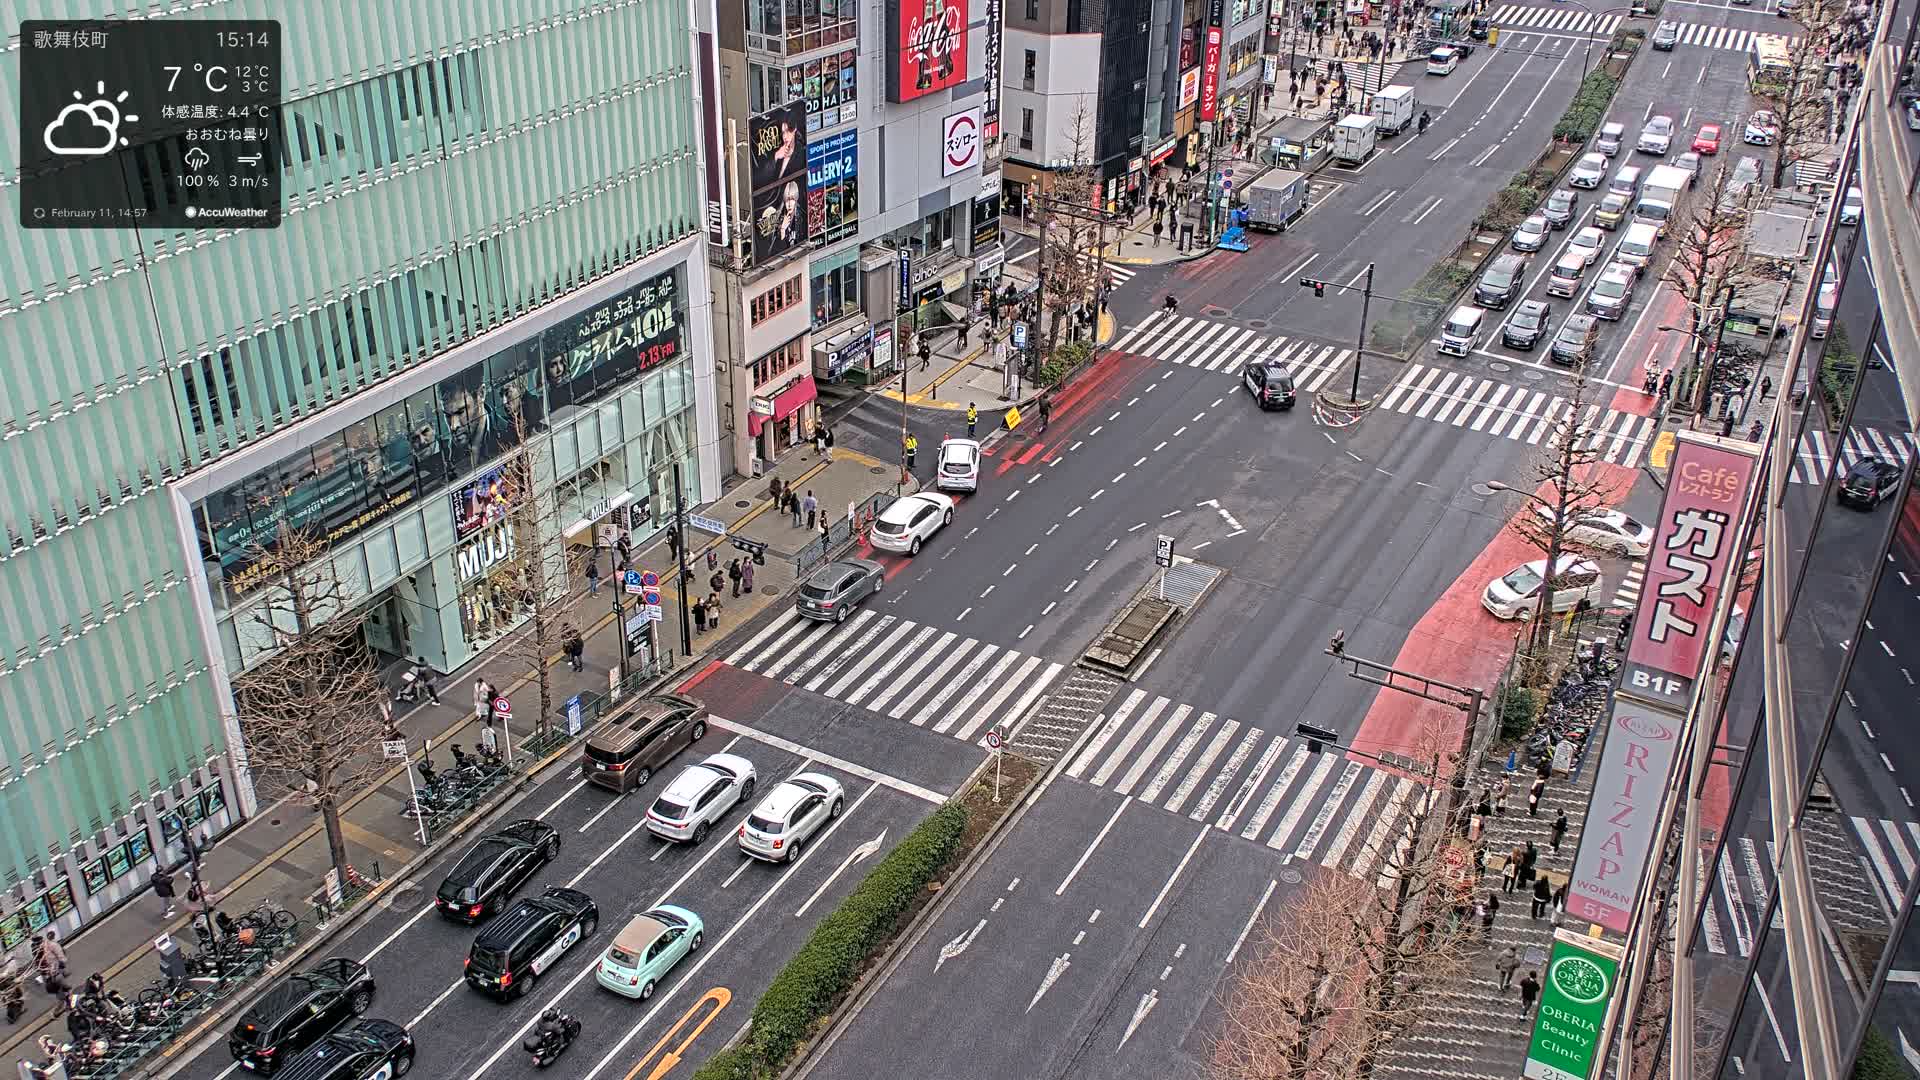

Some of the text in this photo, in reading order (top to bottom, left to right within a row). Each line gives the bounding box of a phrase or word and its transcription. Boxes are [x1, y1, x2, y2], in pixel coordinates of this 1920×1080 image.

[1204, 46, 1219, 112] バーガーキング
[946, 134, 977, 153] スシロー
[709, 200, 721, 234] MUJI
[827, 226, 857, 241] BASKETBALL
[640, 340, 675, 370] 2.13 FRI
[828, 352, 838, 368] P
[1681, 461, 1738, 490] Café
[1678, 482, 1736, 503] レストラン
[591, 497, 613, 520] MUJI
[458, 523, 515, 583] MUJI
[1159, 539, 1167, 549] P
[1649, 508, 1729, 643] ガスト
[1631, 671, 1681, 694] B1F
[1597, 742, 1649, 880] RIZAP
[1577, 879, 1630, 904] WOMAN
[1583, 902, 1610, 921] 5F
[1558, 971, 1599, 991] OBERIA
[1542, 1004, 1596, 1032] OBERIA
[1542, 1020, 1589, 1047] Beauty
[1541, 1039, 1582, 1062] Clinic
